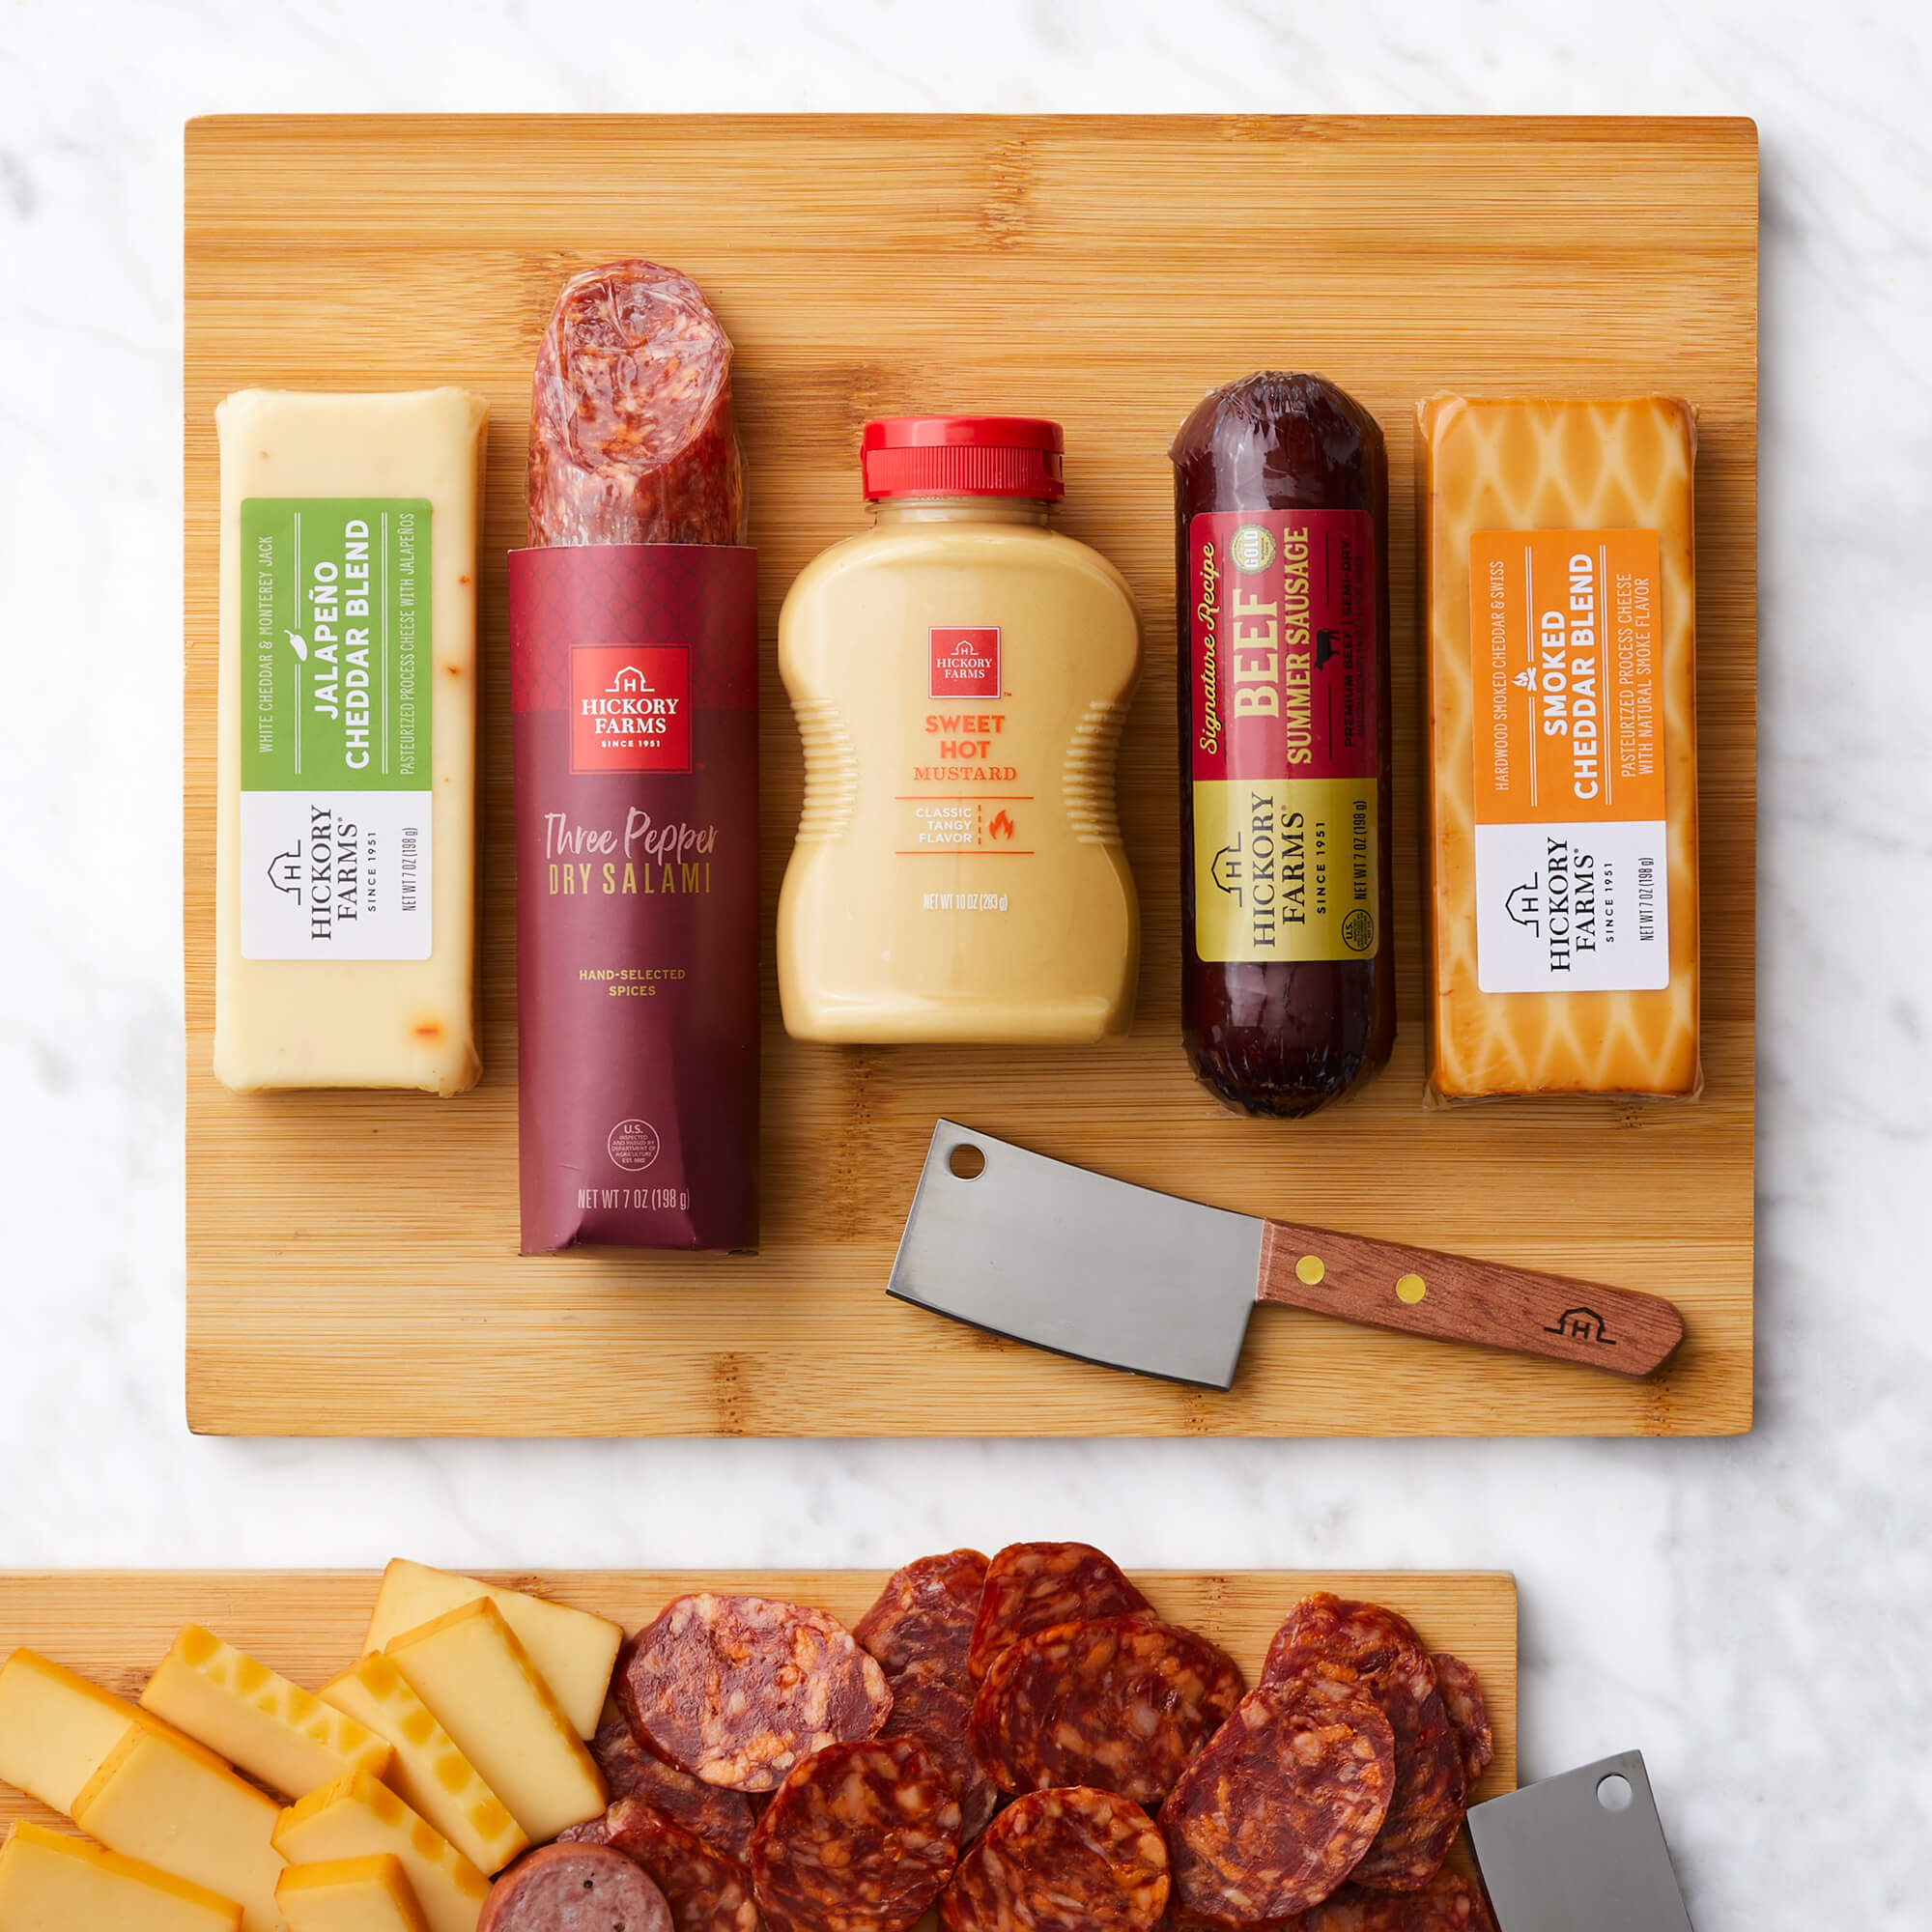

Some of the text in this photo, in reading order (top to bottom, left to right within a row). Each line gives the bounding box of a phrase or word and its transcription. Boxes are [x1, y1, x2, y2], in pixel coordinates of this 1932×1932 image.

[259, 536, 272, 565] JACK
[1243, 530, 1259, 568] GOLD
[259, 572, 272, 635] MONTEREY
[309, 561, 338, 720] JALAPEÑO
[345, 520, 369, 769] CHEDDAR BLEND
[397, 513, 414, 775] PASTEURIZED PROCESS CHEESE WITH JALAPEÑOS
[1197, 542, 1222, 754] Signature Recipe
[1284, 527, 1312, 764] SUMMER SAUSAGE
[1340, 540, 1353, 748] PREMIUM BEEF SEMI-DRY
[1233, 588, 1279, 719] BEEF
[936, 658, 993, 668] HICKORY
[259, 652, 272, 711] CHEDDAR
[945, 668, 985, 679] FARMS
[1490, 560, 1509, 790] HARDWOOD SMOKED CHEDDAR & SWISS
[1542, 611, 1568, 736] SMOKED
[1569, 554, 1599, 799] CHEDDAR BLEND
[1616, 573, 1635, 777] PASTEURIZED PROCESS CHEESE
[1634, 578, 1654, 775] WITH NATURAL SMOKE FLAVOR
[624, 679, 636, 692] H
[582, 698, 679, 715] HICKORY
[594, 718, 667, 734] FARMS
[925, 715, 1006, 733] SWEET
[259, 717, 272, 753] WHITE
[940, 741, 991, 758] HOT
[913, 766, 1017, 781] MUSTARD
[916, 808, 972, 818] CLASSIC
[927, 820, 972, 831] TANGY
[545, 807, 719, 867] Three Pepper
[919, 833, 973, 843] FLAVOR
[1353, 837, 1367, 850] OZ
[402, 838, 417, 856] (198
[402, 859, 416, 870] OZ
[1226, 862, 1241, 877] H
[1252, 791, 1275, 948] HICKORY
[1316, 822, 1325, 914] SINCE 1951
[1354, 861, 1367, 879] WT
[1637, 857, 1654, 867] g)
[284, 866, 300, 879] H
[311, 805, 331, 940] HICKORY
[402, 872, 416, 881] 7
[549, 863, 710, 895] DRY SALAMI
[1638, 867, 1654, 886] (198
[402, 880, 416, 895] WT
[1354, 881, 1367, 899] NET
[1638, 889, 1653, 900] OZ
[402, 895, 416, 911] NET
[923, 894, 938, 910] NET
[940, 894, 952, 910] WT
[955, 894, 966, 910] 10
[967, 894, 979, 910] OZ
[1522, 898, 1538, 912] H
[1548, 837, 1570, 973] HICKORY
[1639, 911, 1654, 924] WT
[1639, 925, 1654, 941] NET
[580, 969, 686, 980] HAND-SELECTED
[609, 985, 656, 997] SPICES
[623, 1124, 644, 1134] U.S.
[578, 1188, 690, 1211] NET WT 7 OZ (198 g)
[1572, 1321, 1591, 1339] H
